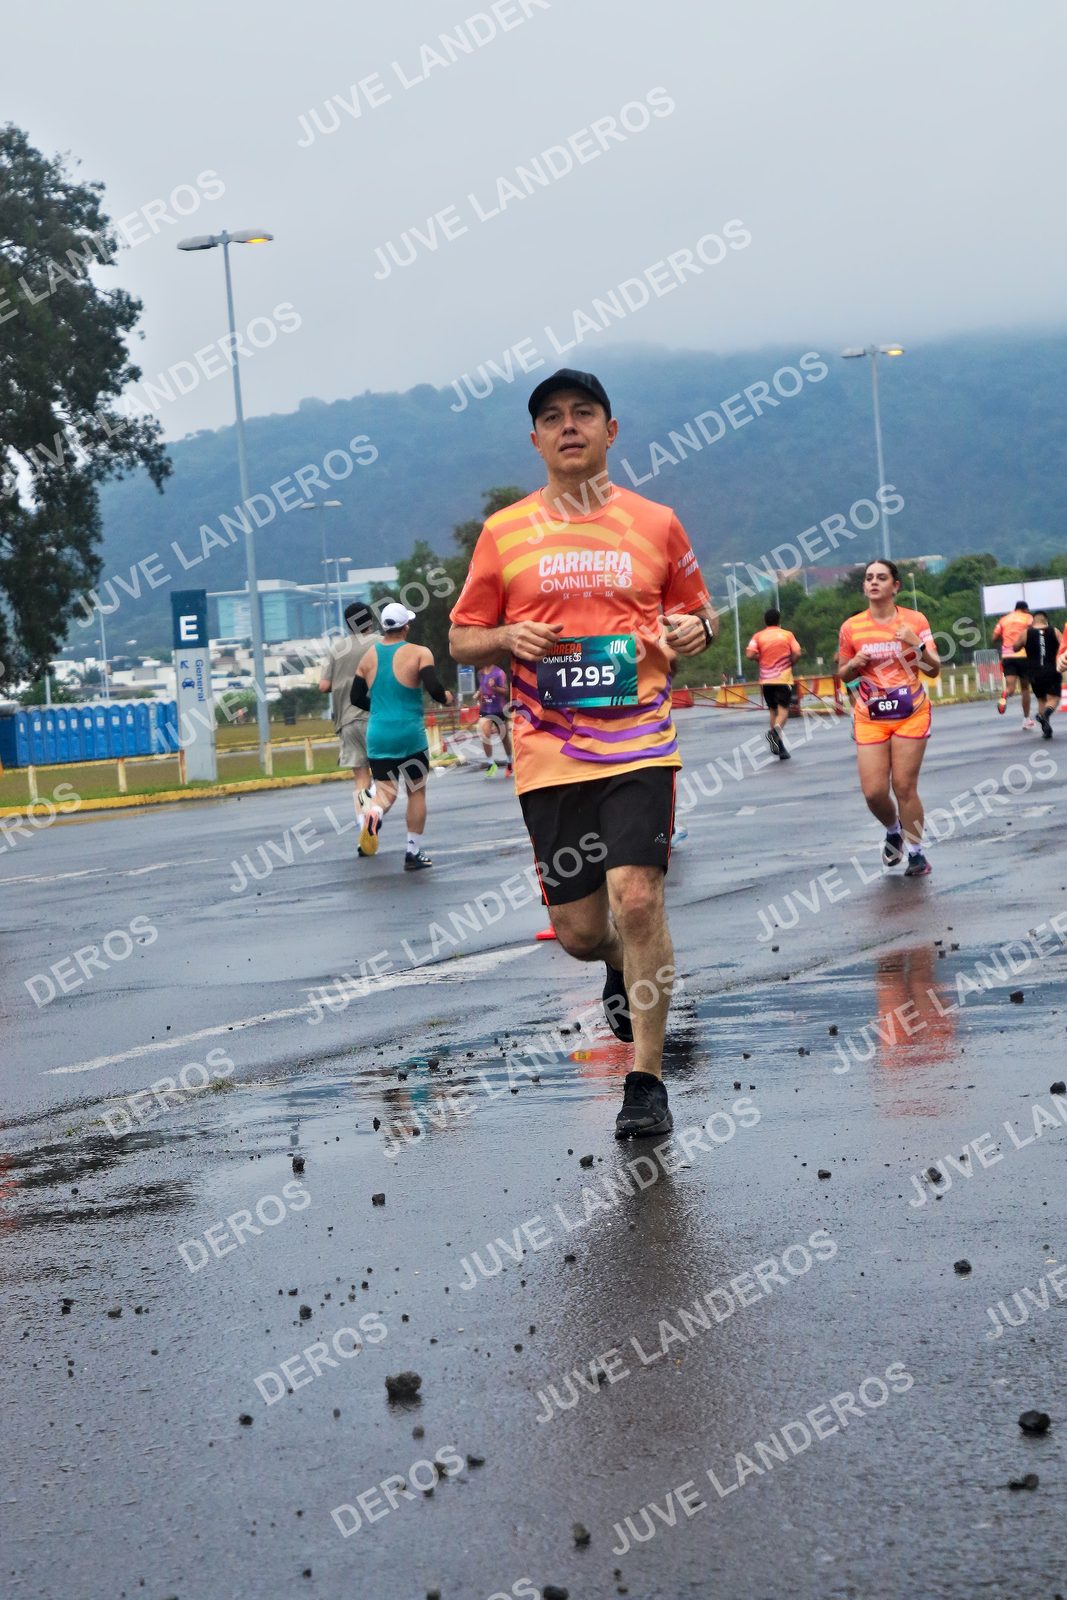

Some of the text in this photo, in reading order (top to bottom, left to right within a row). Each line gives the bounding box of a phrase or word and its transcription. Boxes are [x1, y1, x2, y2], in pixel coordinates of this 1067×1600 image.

[539, 550, 632, 577] CARRERA
[541, 574, 613, 593] OMNILIFE
[180, 614, 199, 640] E
[546, 642, 582, 655] ARRERA
[610, 640, 628, 654] 10K
[543, 655, 572, 664] OMNILIFE
[195, 659, 205, 702] General
[556, 665, 616, 688] 1295
[878, 699, 899, 711] 687
